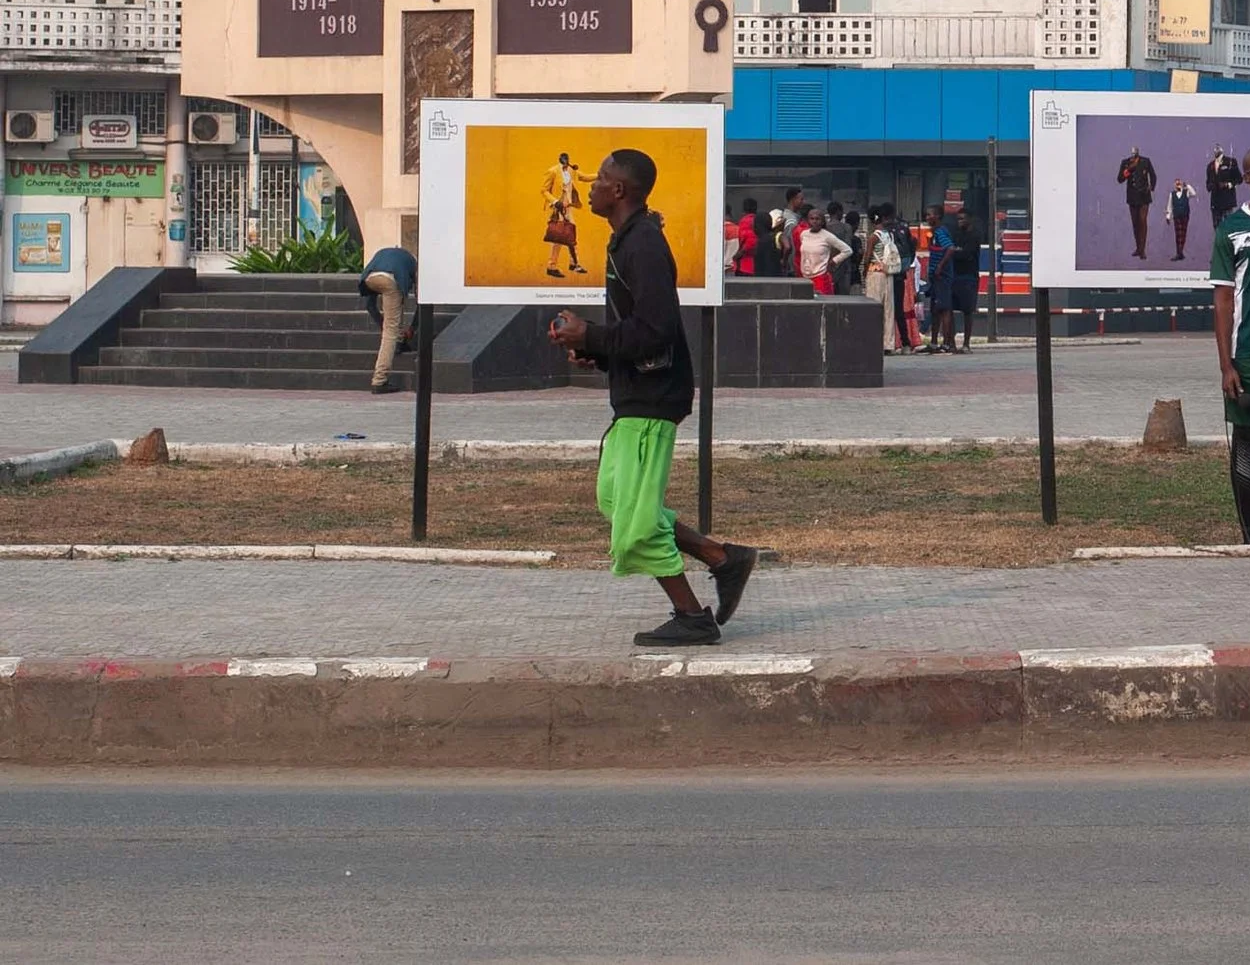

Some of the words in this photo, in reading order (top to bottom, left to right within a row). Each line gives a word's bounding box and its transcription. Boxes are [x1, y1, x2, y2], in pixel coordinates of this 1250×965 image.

[319, 14, 357, 35] 1918
[559, 10, 600, 31] 1945
[9, 161, 81, 179] UNIVERS
